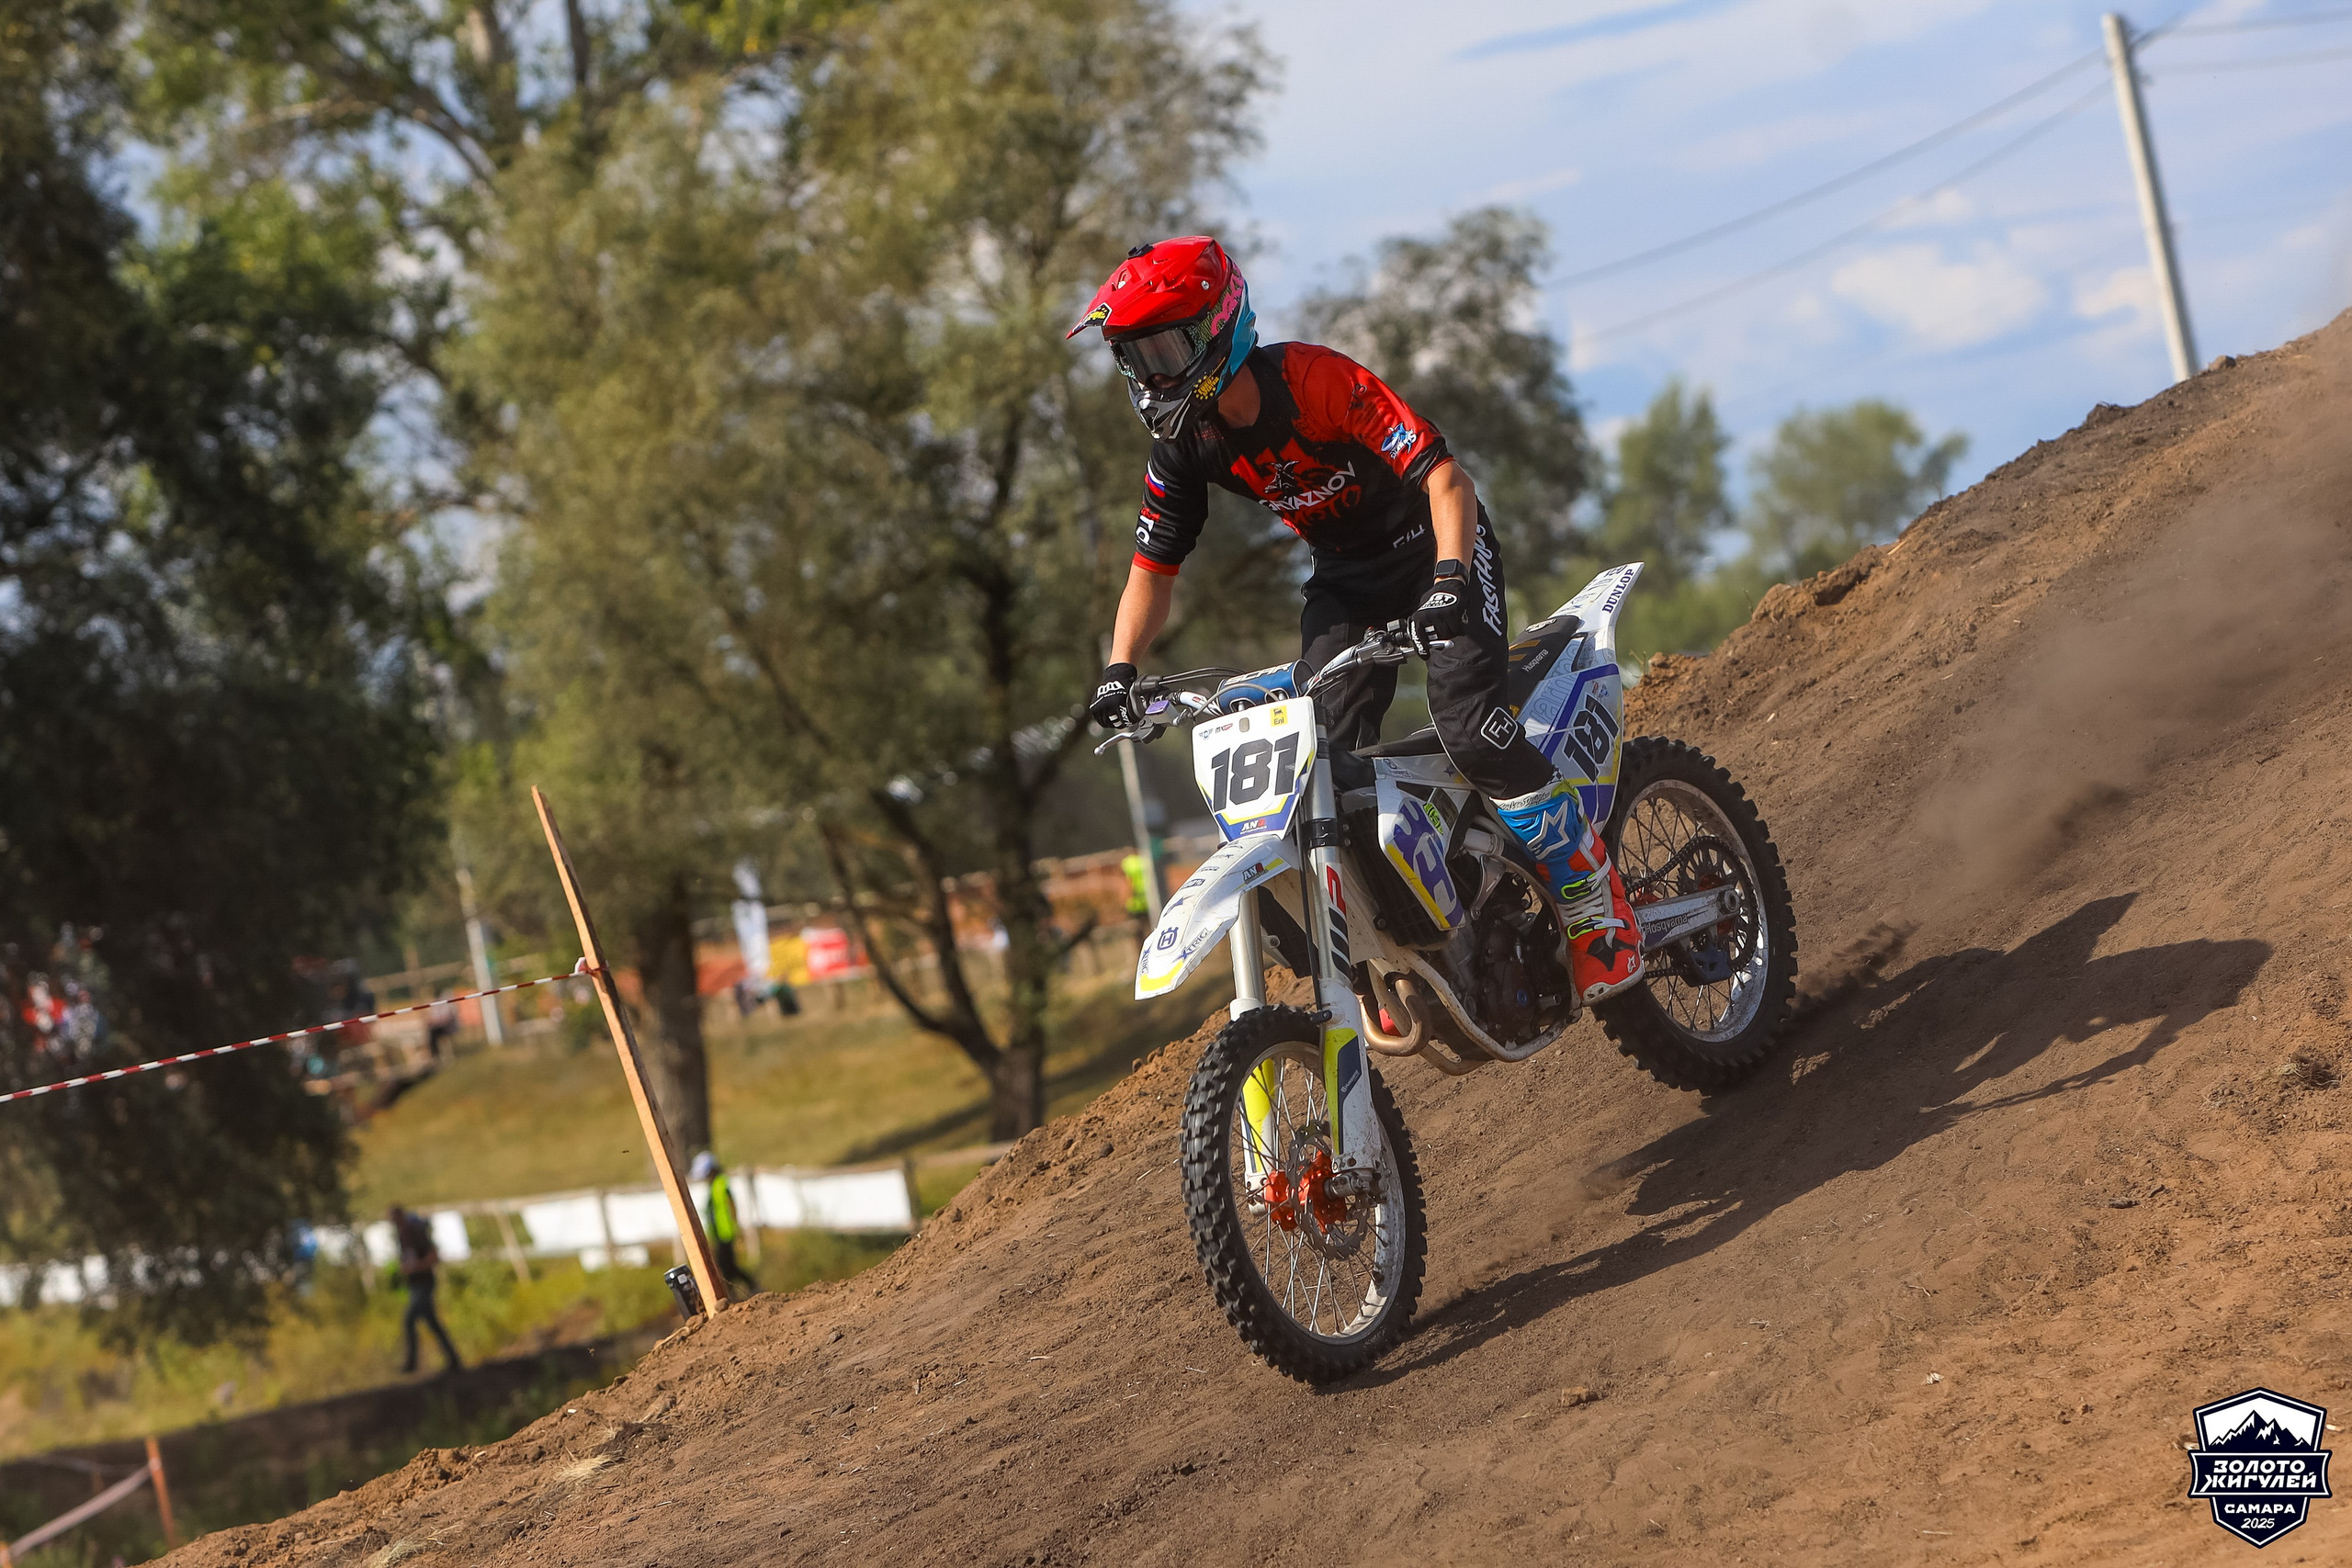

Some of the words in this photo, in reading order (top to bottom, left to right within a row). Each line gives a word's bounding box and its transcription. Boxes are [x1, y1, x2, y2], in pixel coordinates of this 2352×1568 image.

[1602, 569, 1634, 614] DUNLOP
[1211, 731, 1300, 813] 181
[1564, 693, 1620, 784] 181
